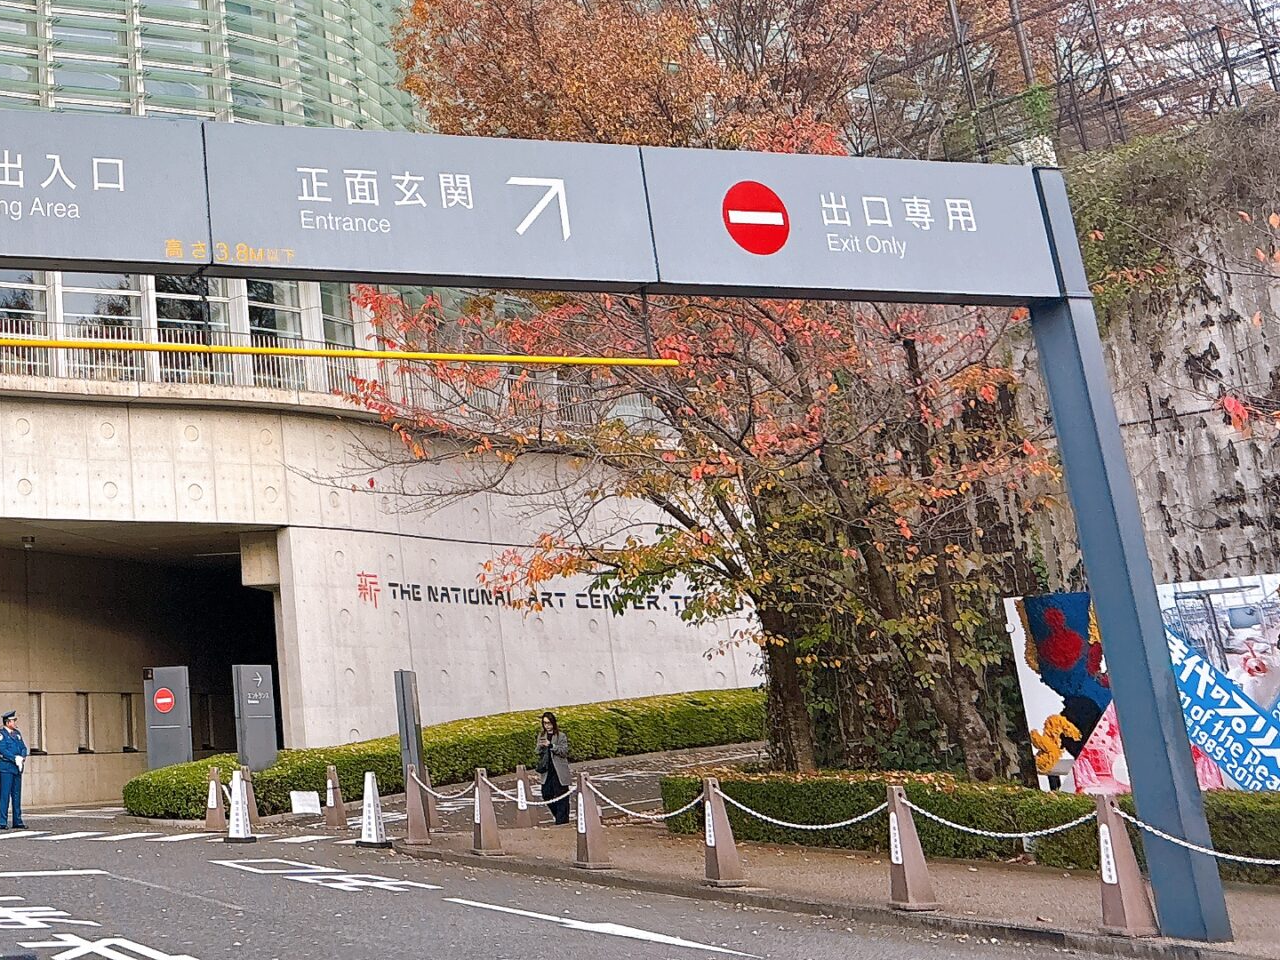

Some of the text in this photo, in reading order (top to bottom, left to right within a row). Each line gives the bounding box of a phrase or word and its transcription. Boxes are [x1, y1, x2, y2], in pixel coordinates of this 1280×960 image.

[296, 166, 474, 210] 正面玄関
[30, 196, 81, 220] Area
[819, 191, 978, 232] 出口専用
[300, 209, 392, 234] Entrance
[827, 233, 907, 259] Exit Only
[387, 582, 422, 602] THE
[1190, 705, 1216, 727] of
[1211, 720, 1245, 758] the
